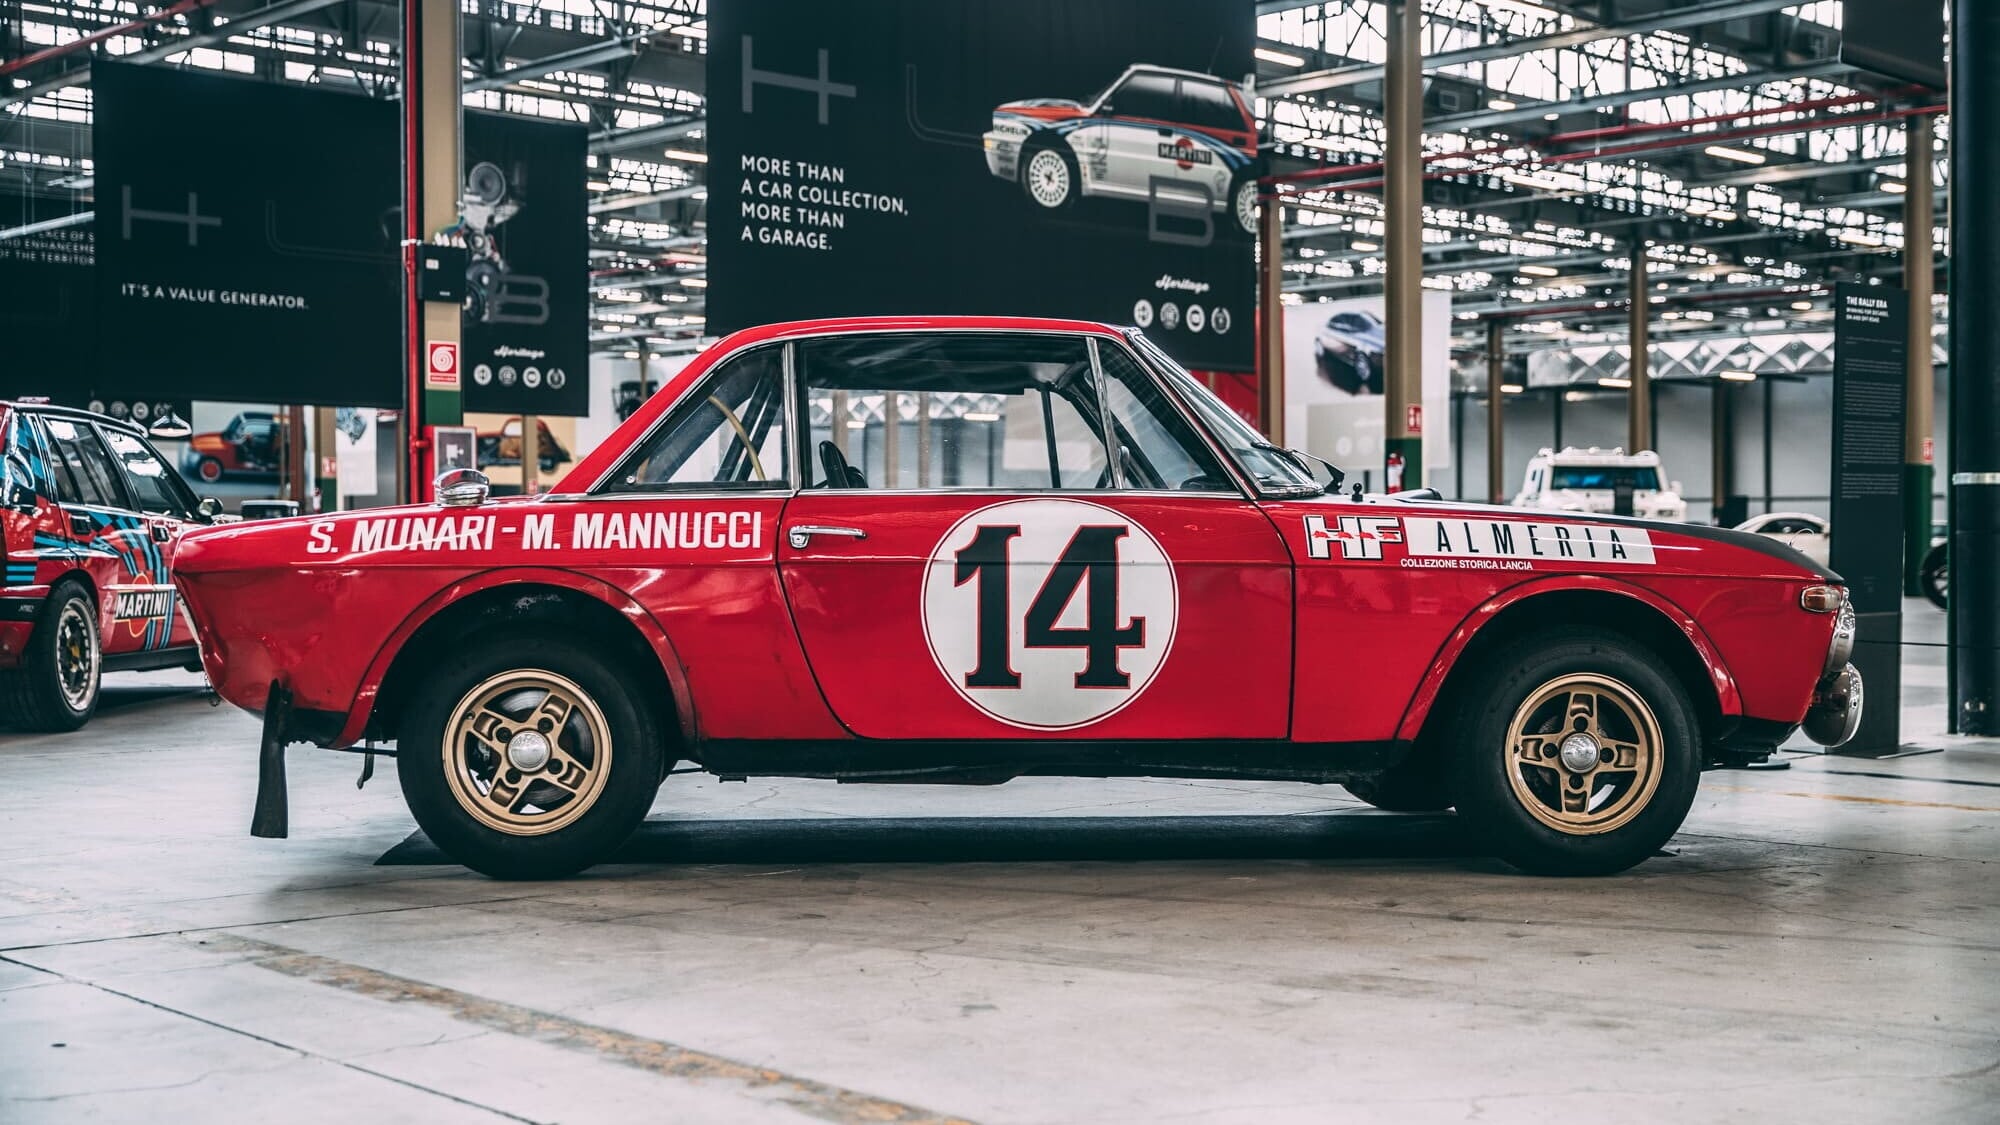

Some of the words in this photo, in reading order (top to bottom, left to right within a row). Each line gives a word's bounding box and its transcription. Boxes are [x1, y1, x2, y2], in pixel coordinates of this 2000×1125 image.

[1160, 144, 1211, 164] MARTINI
[741, 154, 791, 177] MORE
[796, 161, 844, 183] THAN
[741, 178, 753, 195] A
[758, 180, 793, 200] CAR
[741, 201, 791, 223] MORE
[796, 207, 844, 229] THAN
[741, 225, 753, 242] A
[758, 226, 832, 250] GARAGE.
[16, 249, 36, 261] THE
[122, 282, 150, 297] IT'S
[154, 285, 165, 298] A
[169, 286, 216, 303] VALUE
[220, 290, 310, 310] GENERATOR.
[1155, 274, 1210, 294] Heritage
[1846, 296, 1858, 305] THE
[1858, 297, 1875, 307] RALLY
[1875, 299, 1888, 309] ERA
[307, 521, 339, 555] S.
[351, 515, 497, 553] MUNARI
[501, 526, 517, 534] -
[522, 513, 561, 550] M.
[572, 511, 762, 550] MANNUCCI
[1303, 514, 1404, 561] HF
[1436, 520, 1628, 560] ALMERIA
[1400, 557, 1458, 569] COLLEZIONE
[1459, 559, 1499, 570] STORICA
[1499, 560, 1534, 571] LANCIA
[115, 592, 168, 618] MARTINI
[954, 524, 1146, 690] 14
